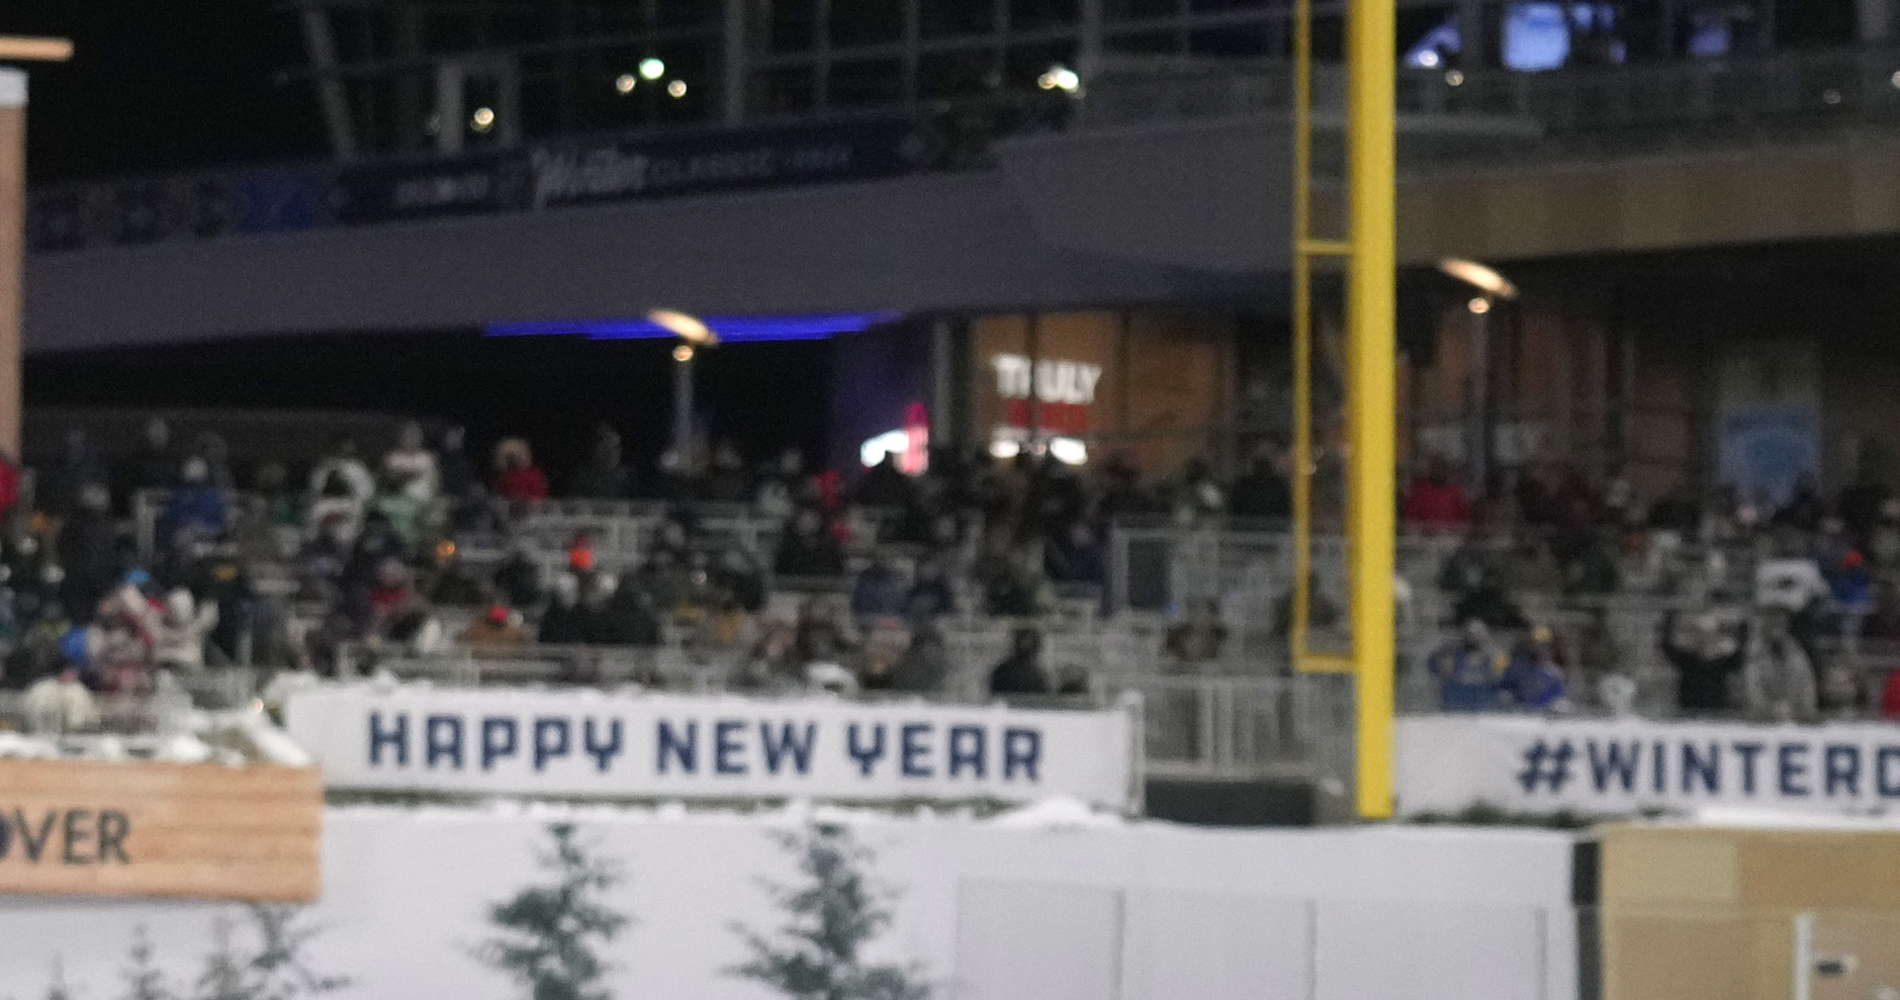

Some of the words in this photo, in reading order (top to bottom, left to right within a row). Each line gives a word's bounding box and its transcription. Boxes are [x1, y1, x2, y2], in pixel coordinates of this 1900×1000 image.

[367, 710, 625, 773] HAPPY
[656, 719, 819, 776] NEW
[846, 721, 1045, 783] YEAR
